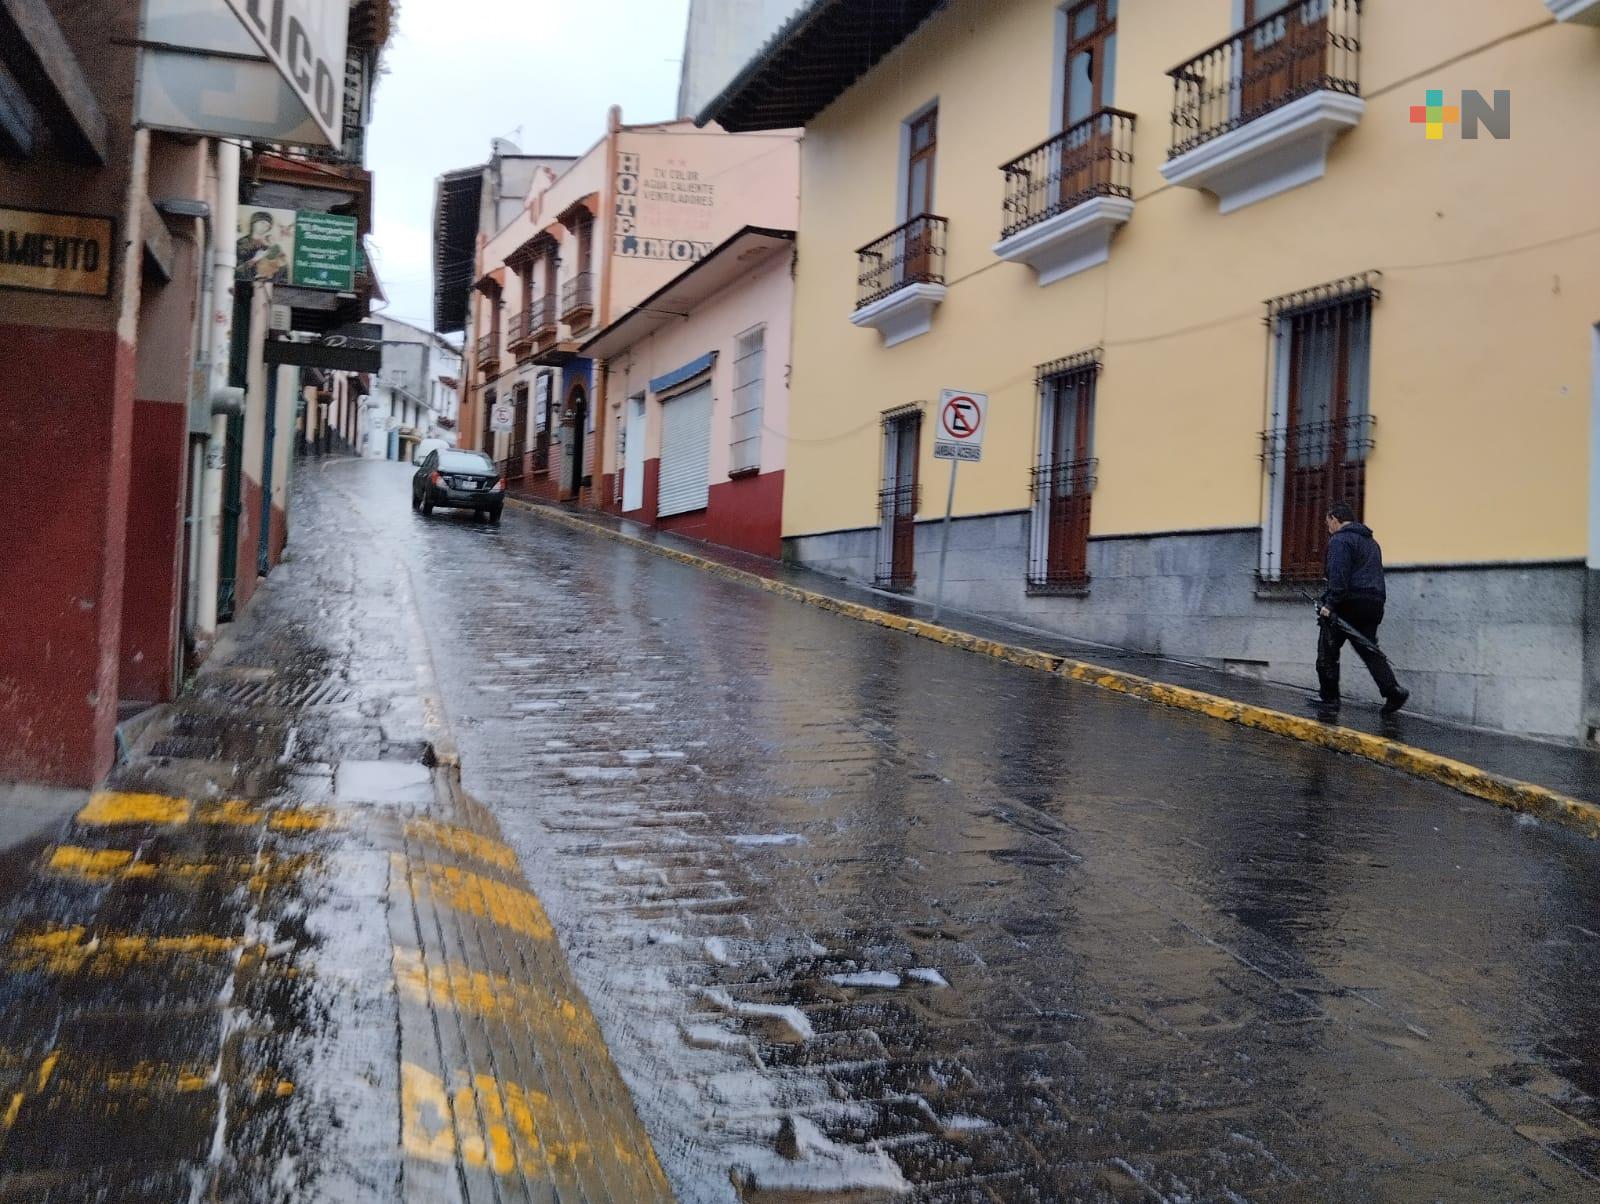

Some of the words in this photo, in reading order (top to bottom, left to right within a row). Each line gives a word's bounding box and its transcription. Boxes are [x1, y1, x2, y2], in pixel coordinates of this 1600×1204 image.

[669, 169, 699, 181] COLOR
[643, 179, 668, 190] AGUA
[671, 181, 715, 195] CALIENTE
[643, 191, 714, 207] VENTILADORES
